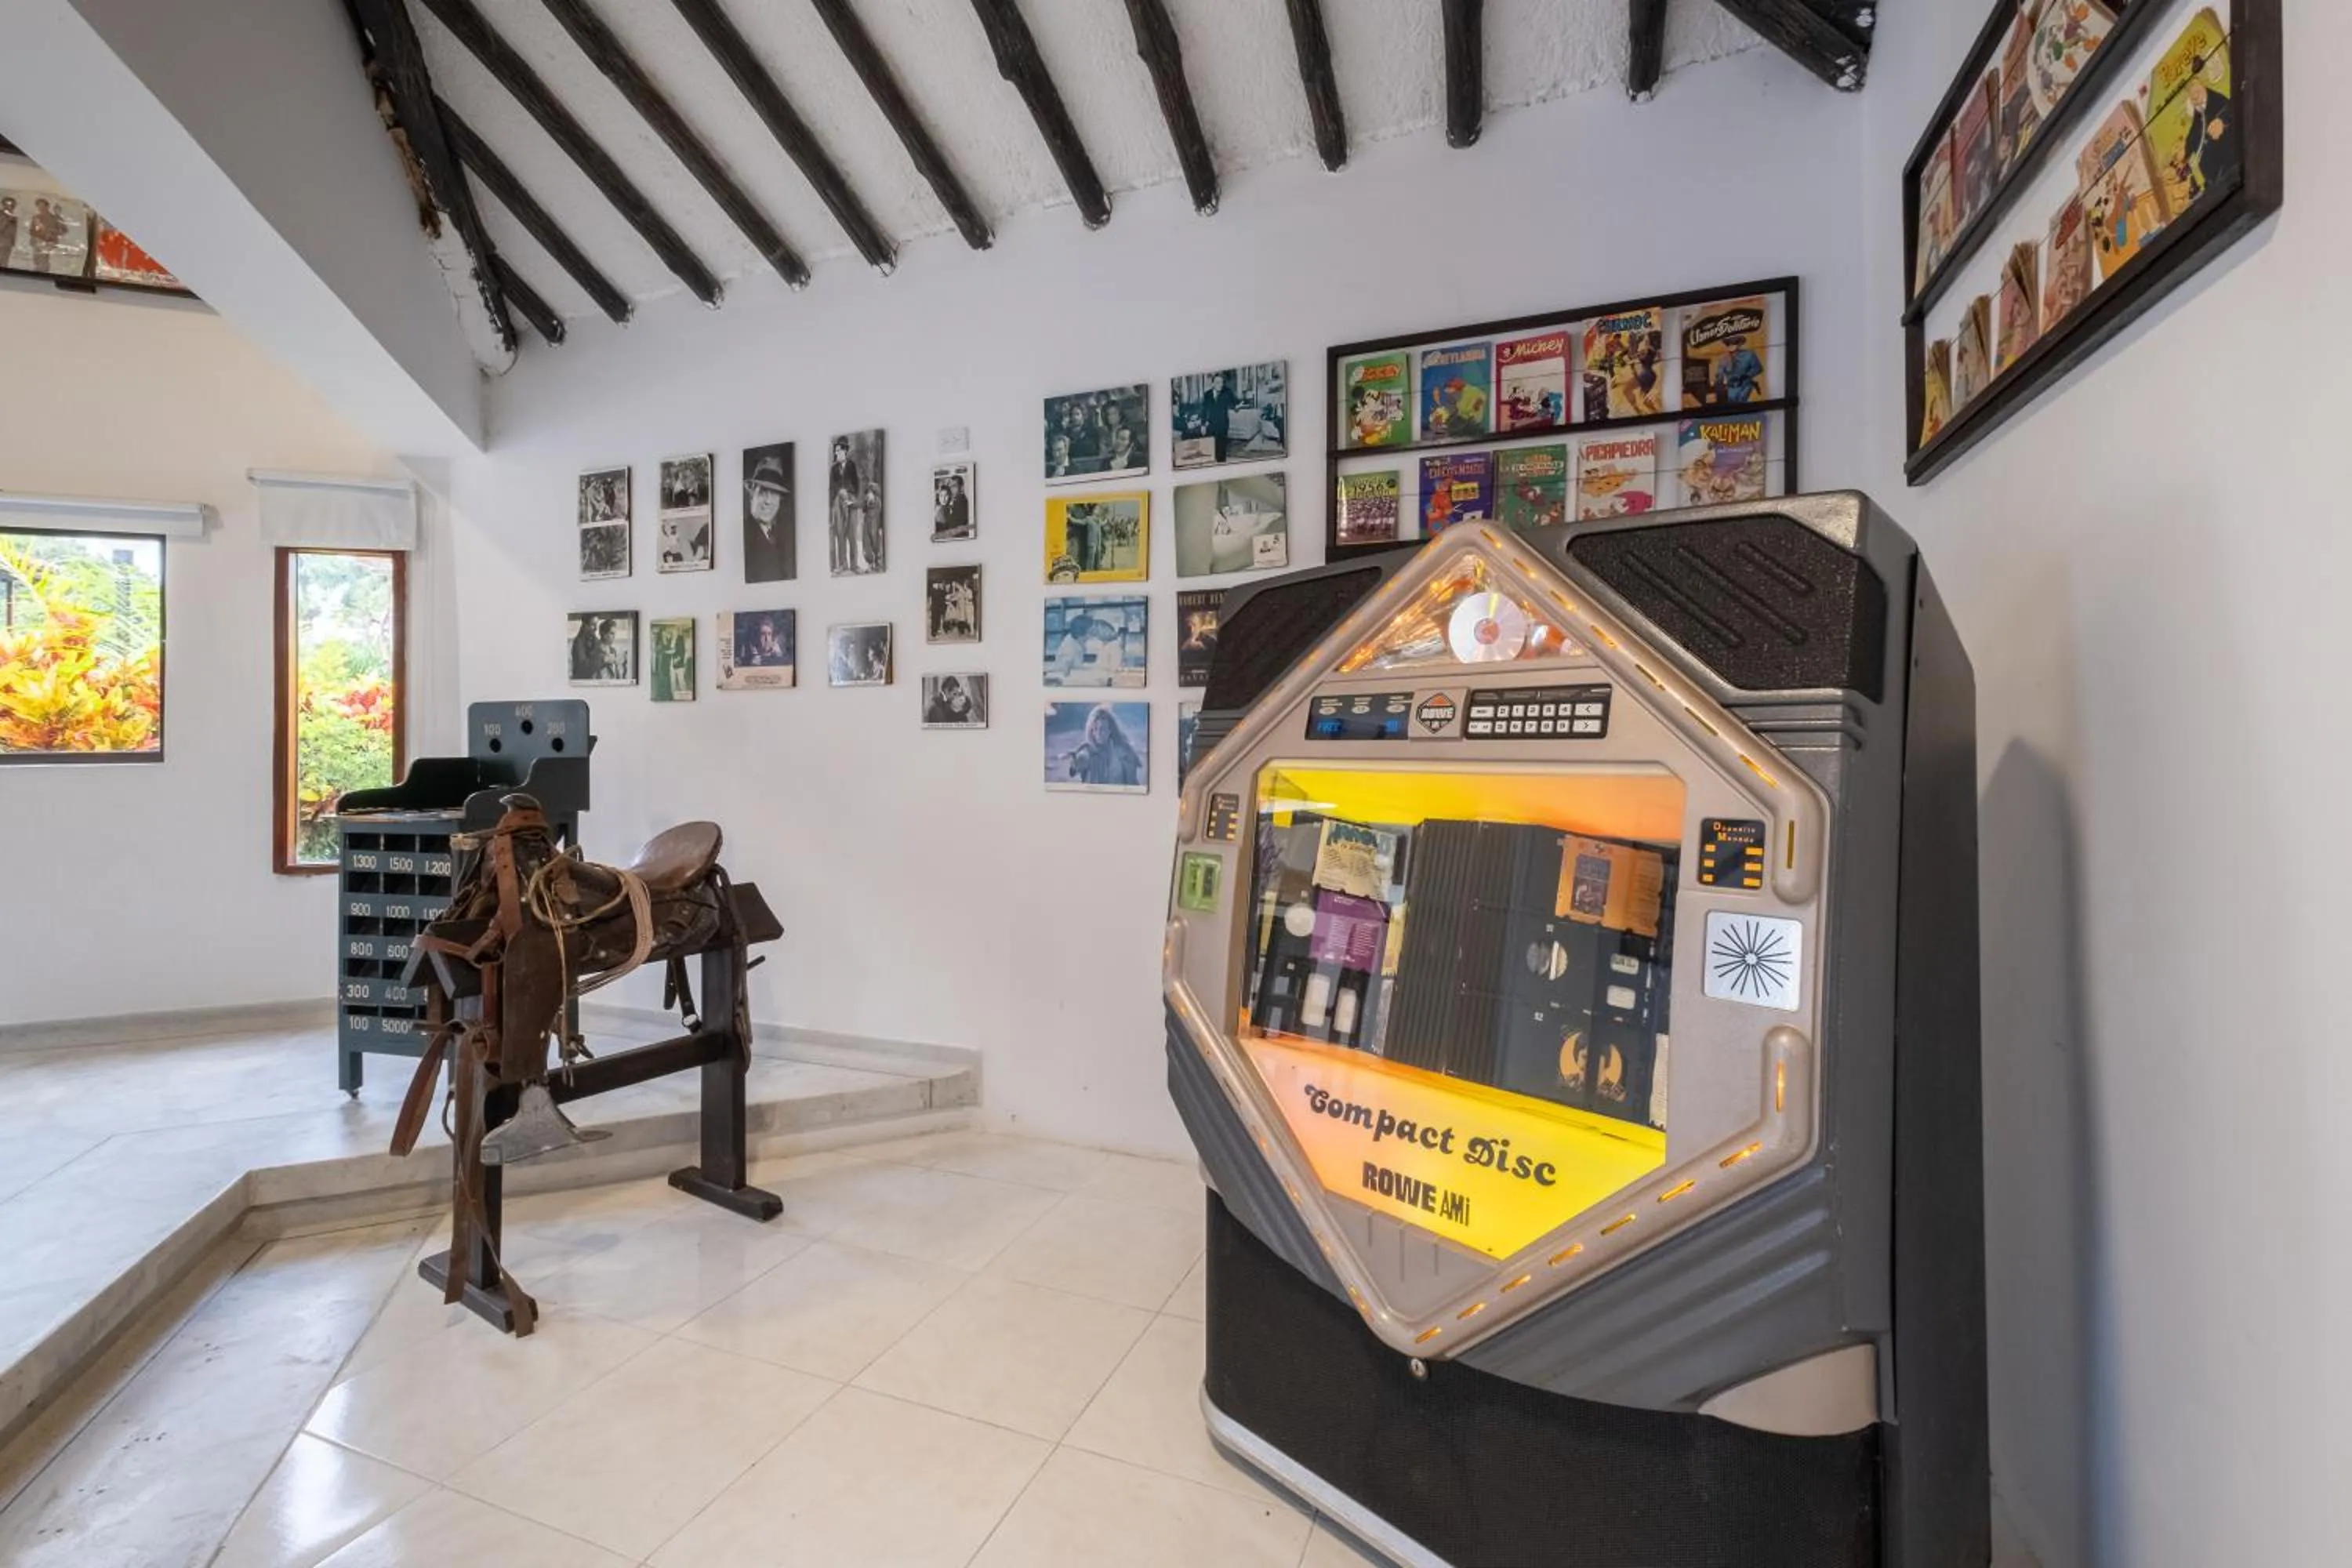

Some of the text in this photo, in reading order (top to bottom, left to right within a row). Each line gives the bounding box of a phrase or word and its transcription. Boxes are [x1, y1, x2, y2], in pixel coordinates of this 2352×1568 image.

[347, 984, 369, 998] 300
[349, 1016, 368, 1031] 100
[1305, 1083, 1557, 1186] Compact Disc
[1362, 1161, 1437, 1214] ROWE
